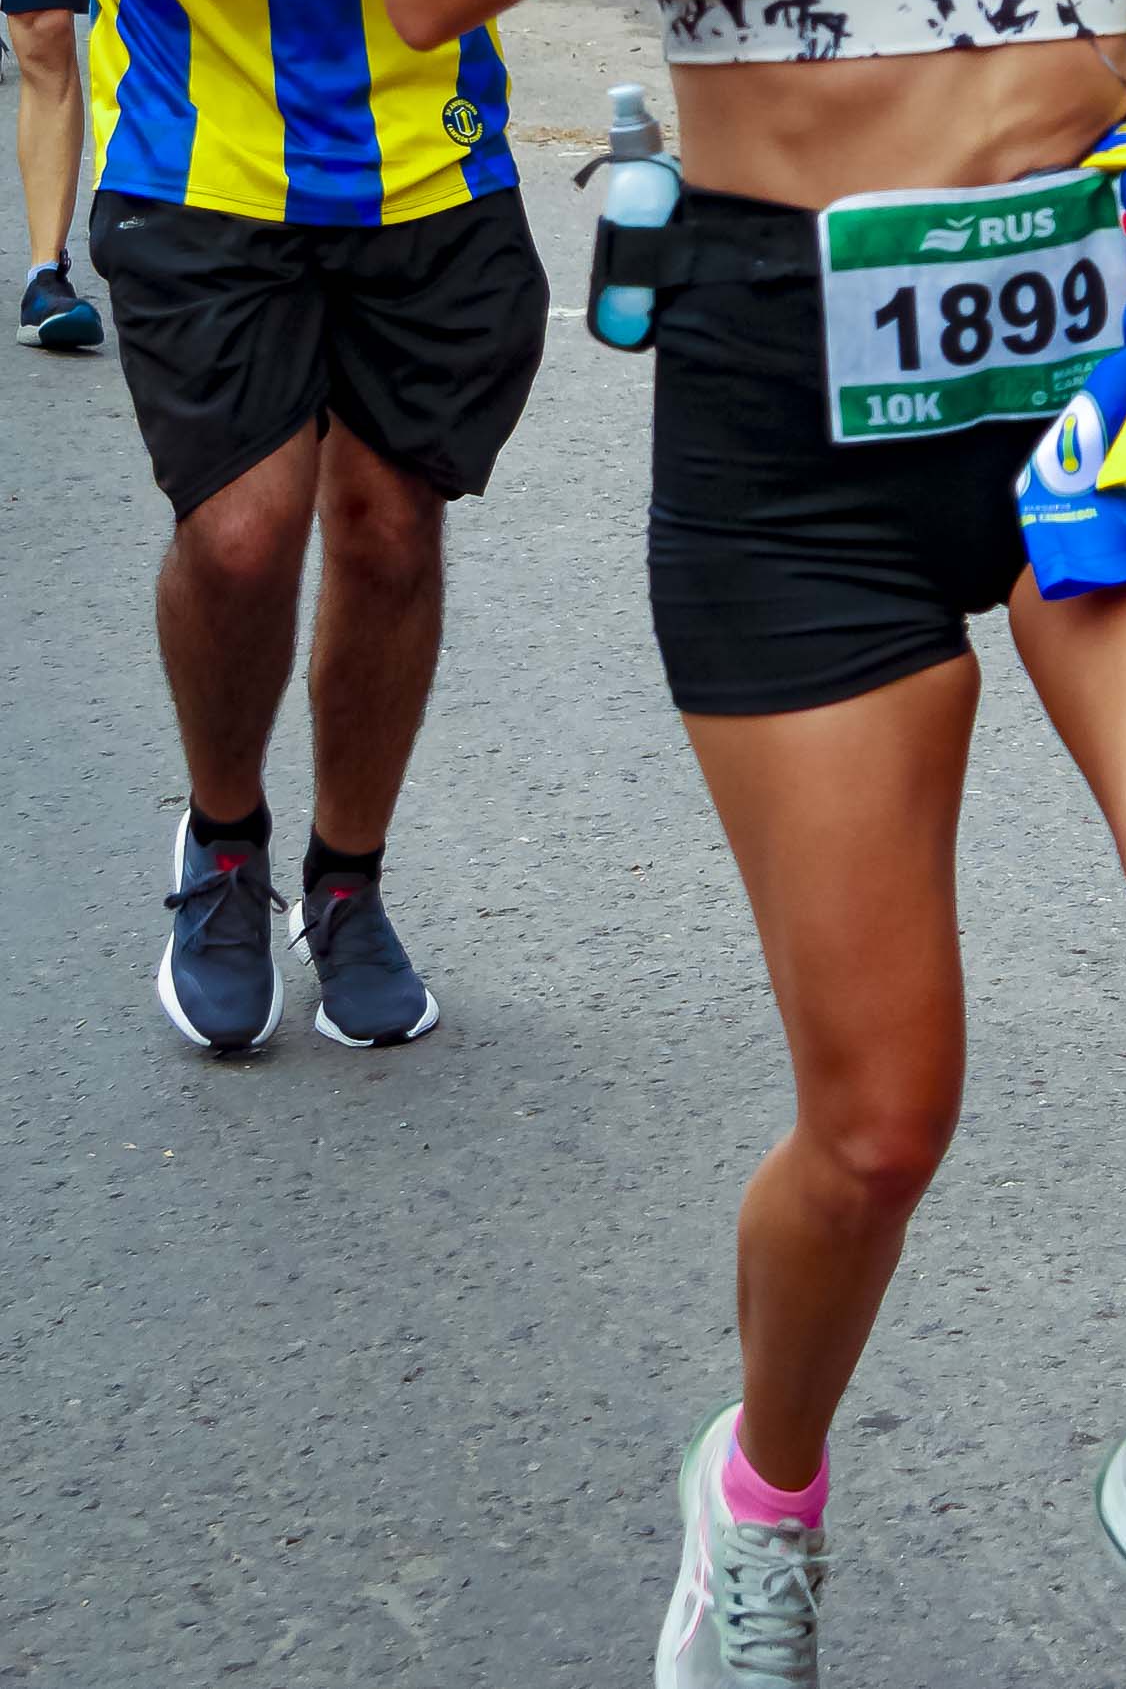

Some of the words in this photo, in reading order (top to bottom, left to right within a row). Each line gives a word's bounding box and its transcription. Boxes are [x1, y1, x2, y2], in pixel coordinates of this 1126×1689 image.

[978, 206, 1056, 248] RUS
[874, 256, 1109, 372] 1899
[866, 391, 943, 426] 10K
